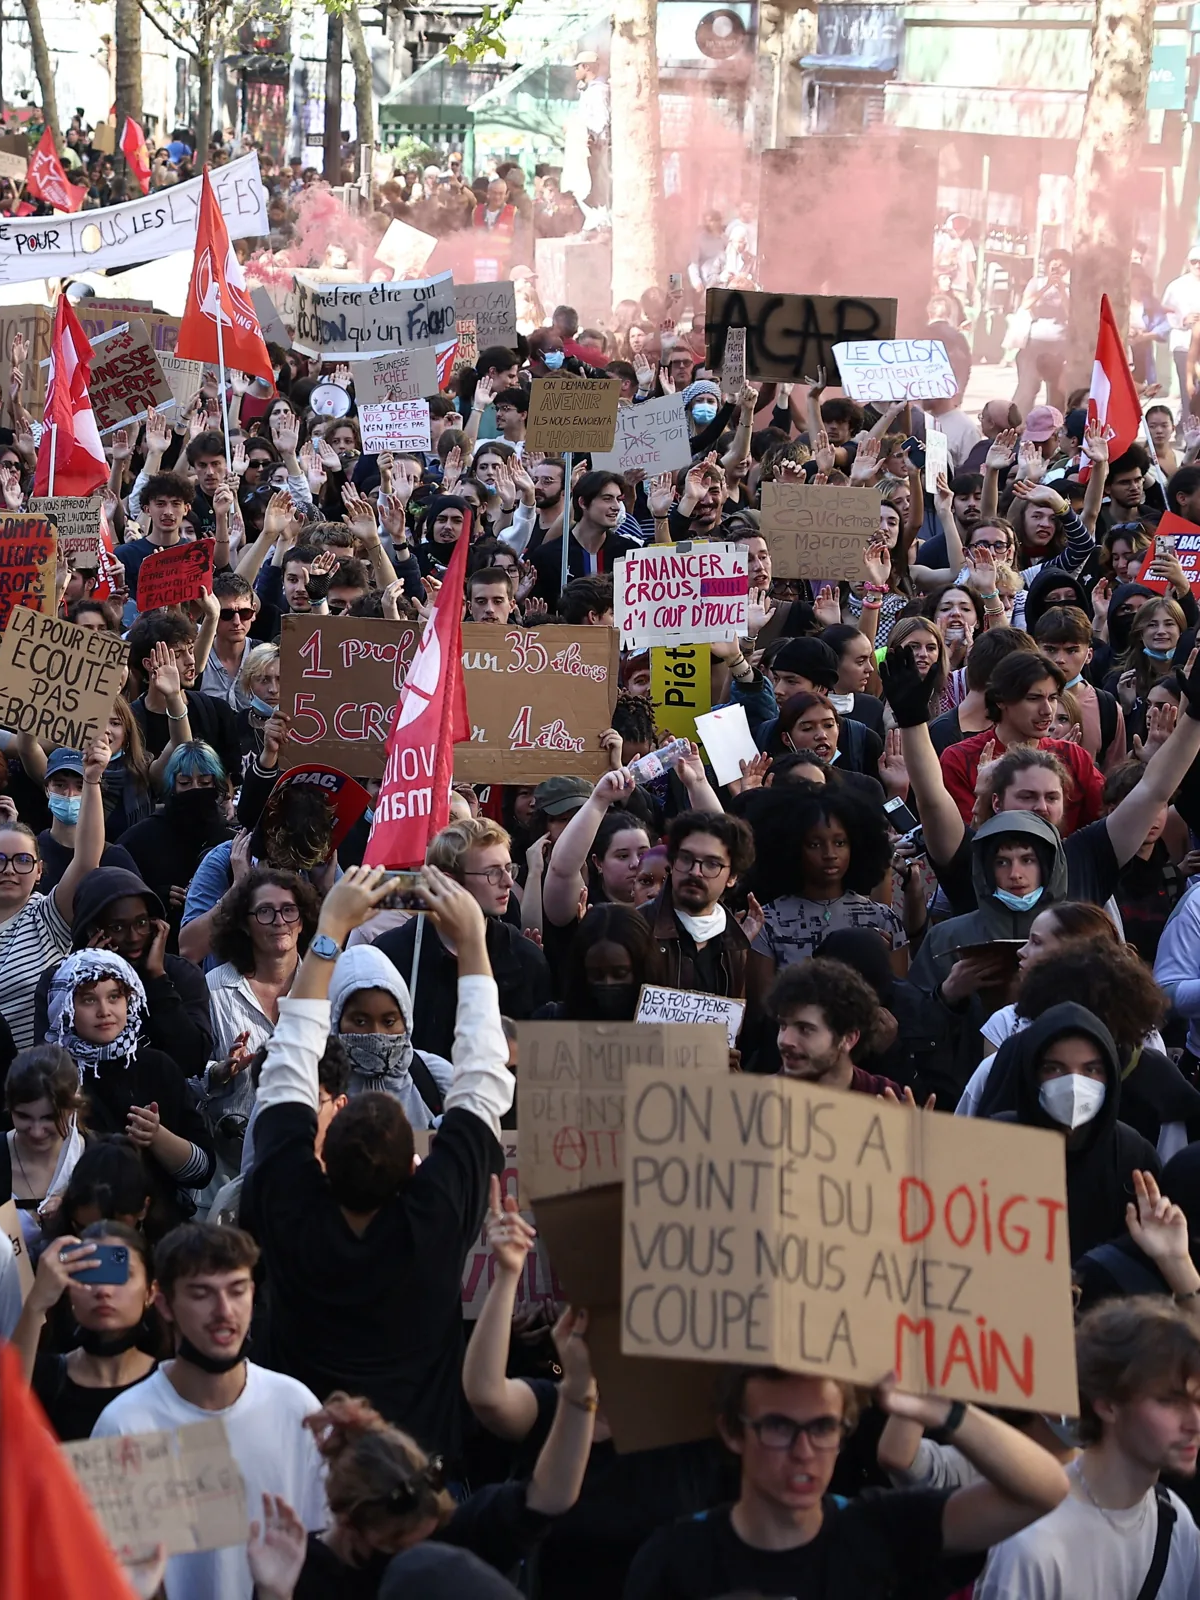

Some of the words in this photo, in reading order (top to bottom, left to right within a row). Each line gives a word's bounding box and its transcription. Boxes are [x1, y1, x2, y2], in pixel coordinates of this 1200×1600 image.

[14, 230, 61, 255] POUR
[56, 212, 130, 257] TOUS
[132, 208, 167, 235] LES
[368, 282, 402, 306] être
[413, 283, 436, 300] un
[346, 319, 402, 353] qu'un
[845, 340, 870, 361] LE
[878, 339, 949, 365] CELSA
[373, 355, 411, 374] JEUNESSE
[854, 365, 921, 383] SOUTIENT
[373, 368, 409, 385] FACHÉE
[542, 380, 556, 391] ON
[560, 380, 599, 392] DEMANDE
[598, 380, 611, 391] UN
[384, 383, 403, 393] PAS
[846, 382, 884, 401] LES
[363, 402, 420, 413] RECYCLEZ
[539, 392, 603, 412] AVENIR
[362, 412, 382, 423] VOS
[385, 422, 409, 432] FAITES
[410, 421, 427, 429] PAS
[533, 415, 548, 426] ILS
[549, 415, 571, 427] NOUS
[645, 409, 687, 427] JEUNE
[385, 430, 403, 438] DES
[658, 425, 685, 443] TOI
[42, 501, 60, 512] NOUS
[793, 534, 862, 552] Macron
[625, 553, 726, 584] FINANCER
[731, 566, 746, 576] le
[145, 586, 193, 608] FACHO
[623, 606, 646, 633] d'1
[690, 601, 746, 628] D'POUCE
[39, 618, 85, 650] POUR
[11, 634, 116, 697] ÉCOUTÉ
[550, 642, 608, 683] élèves
[28, 677, 81, 713] PAS
[535, 718, 586, 754] élève
[639, 1004, 659, 1016] AUX
[643, 990, 667, 1007] DES
[667, 993, 691, 1010] FOIS
[693, 996, 732, 1015] J'PENSE
[729, 1088, 837, 1165] VOUS
[631, 1155, 800, 1221] POINTÉ
[628, 1220, 736, 1278] VOUS
[754, 1228, 847, 1293] NOUS
[863, 1248, 974, 1317] AVEZ
[624, 1282, 771, 1352] COUPÉ
[799, 1299, 858, 1370] LA
[894, 1311, 1035, 1399] MAIN
